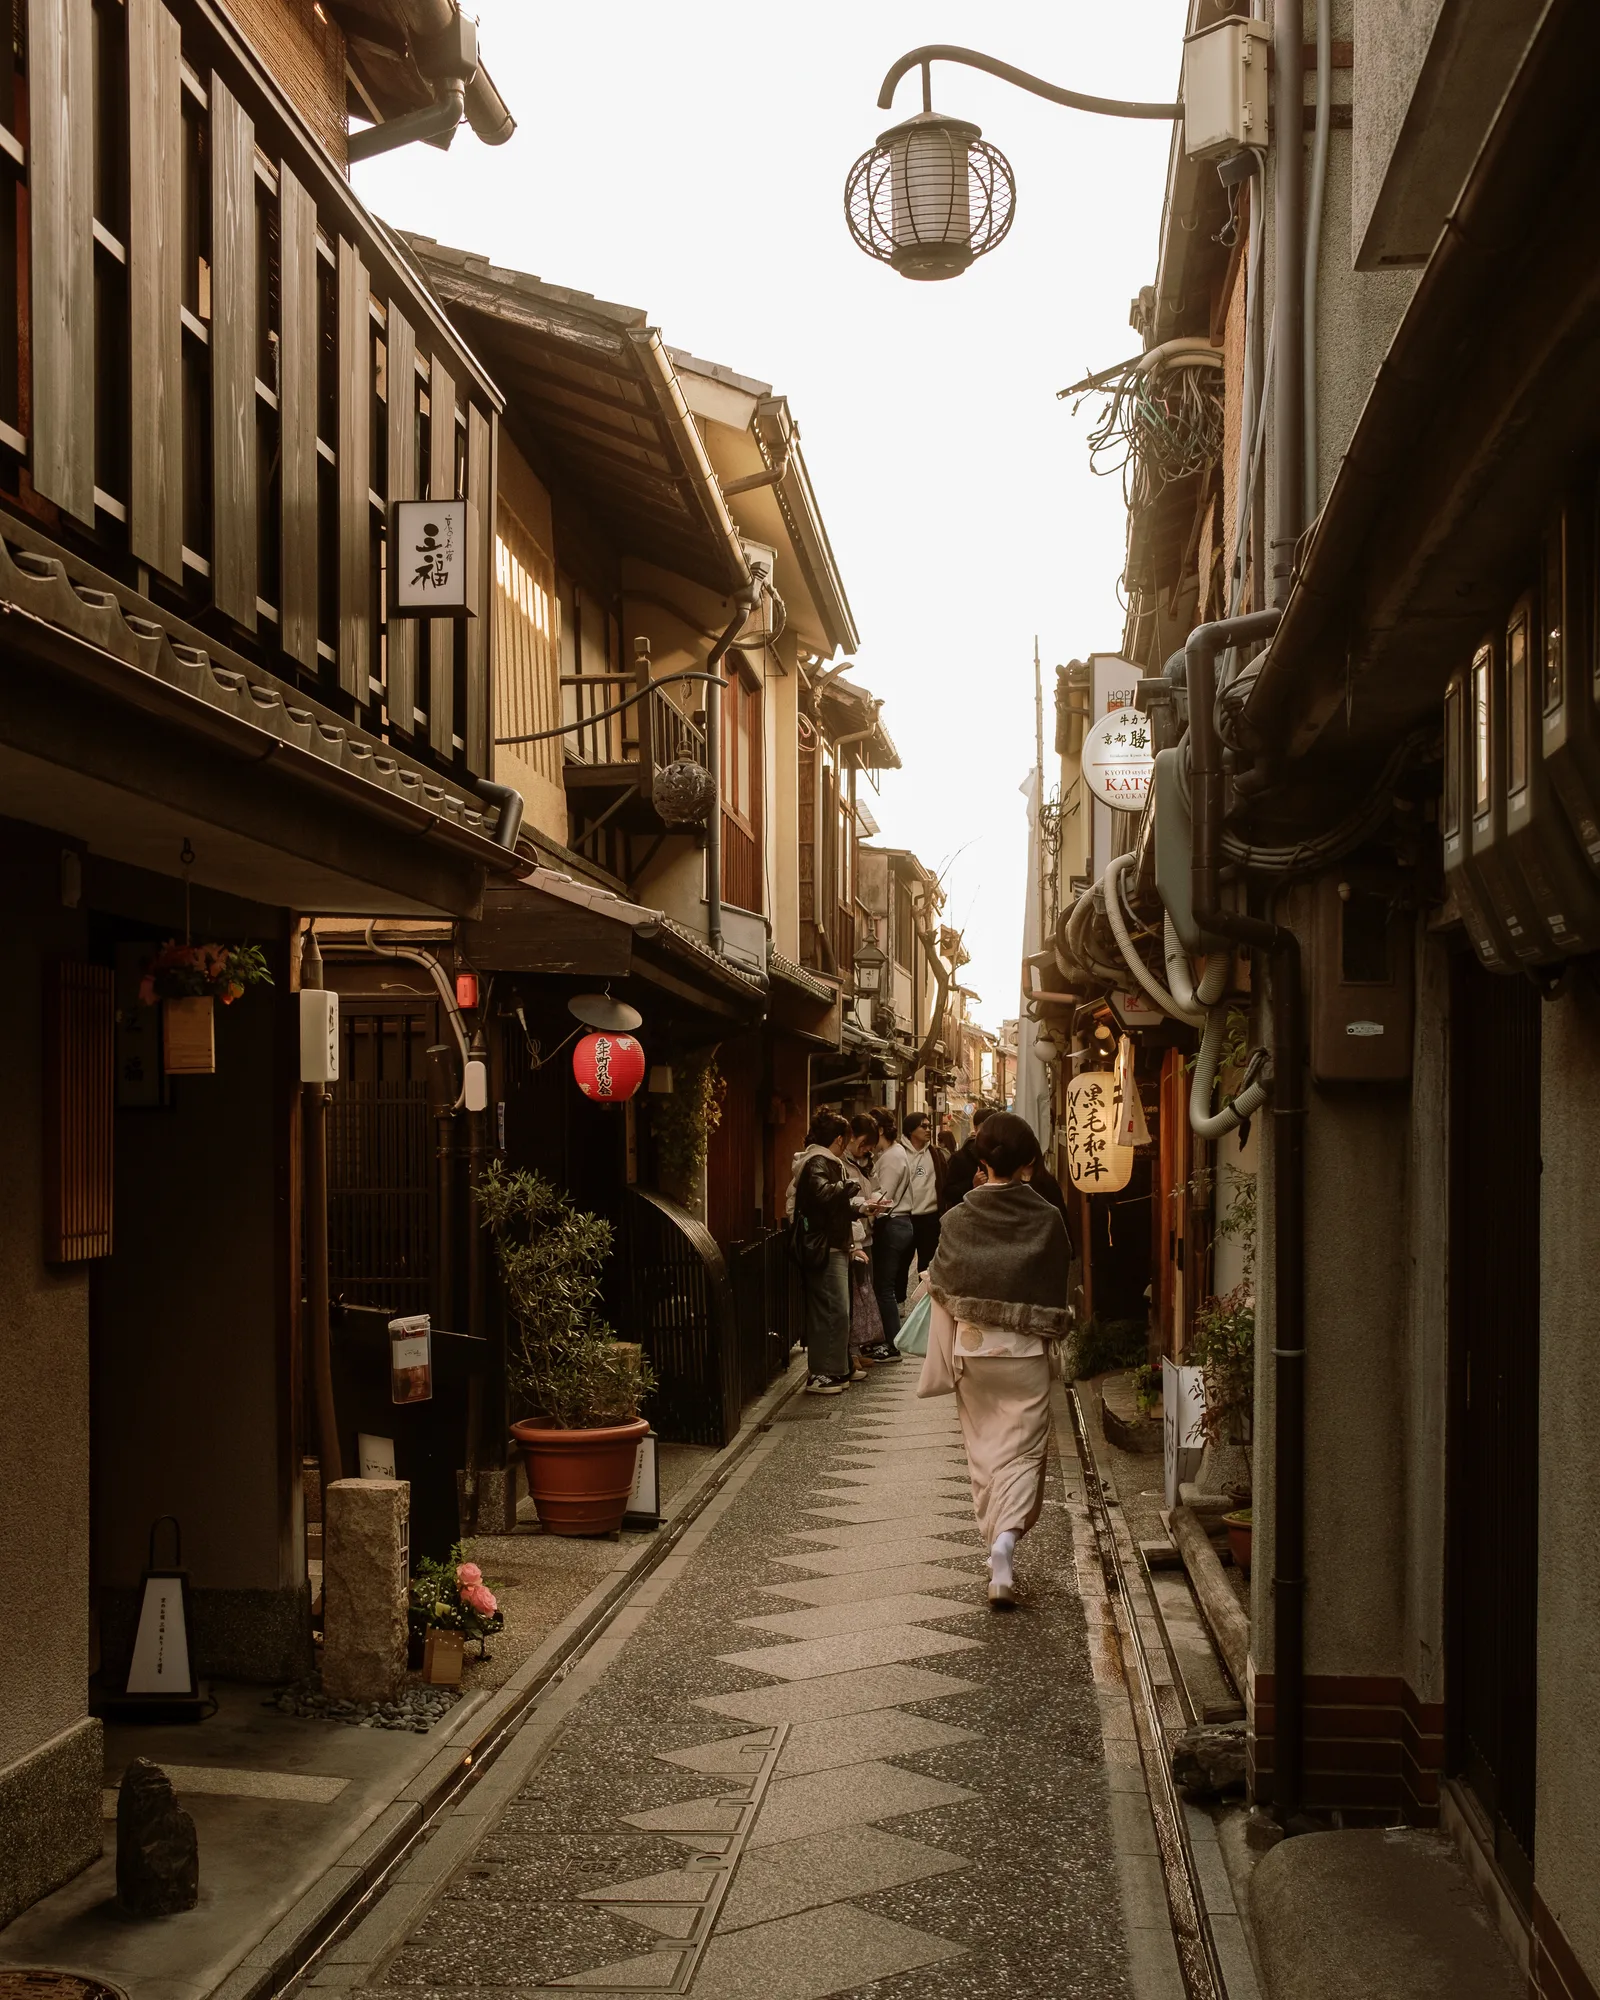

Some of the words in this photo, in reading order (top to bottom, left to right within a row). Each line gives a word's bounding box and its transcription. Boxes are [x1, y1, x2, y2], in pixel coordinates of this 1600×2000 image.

[411, 523, 449, 591] 三福
[1067, 1088, 1082, 1182] WAGYU
[1082, 1083, 1109, 1182] 黒毛和牛
